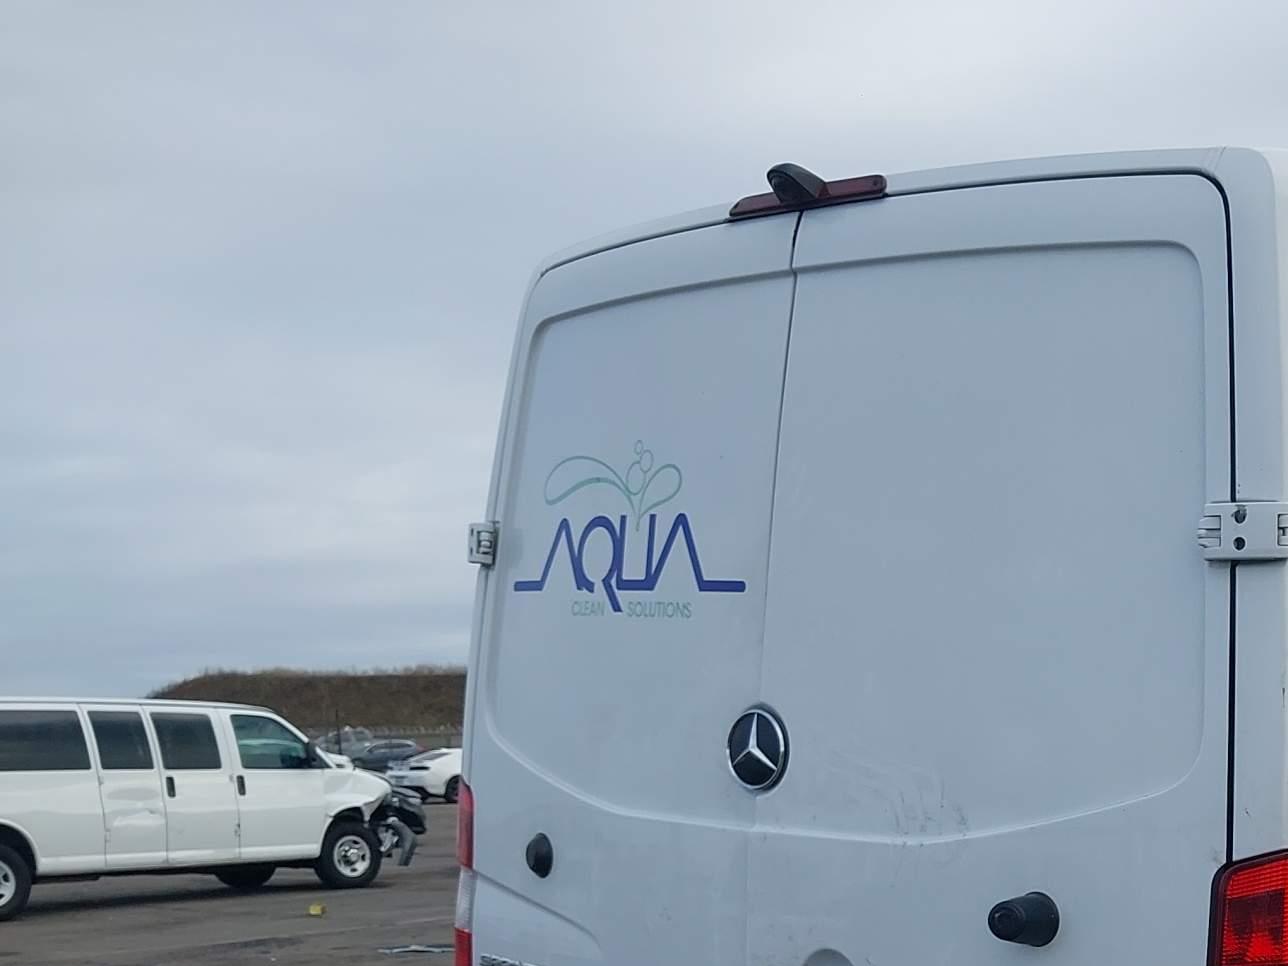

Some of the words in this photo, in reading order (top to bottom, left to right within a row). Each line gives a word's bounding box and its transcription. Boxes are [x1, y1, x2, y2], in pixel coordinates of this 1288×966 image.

[514, 514, 745, 611] AQUA
[571, 600, 605, 617] CLEAN
[626, 601, 692, 618] SOLUTIONS
